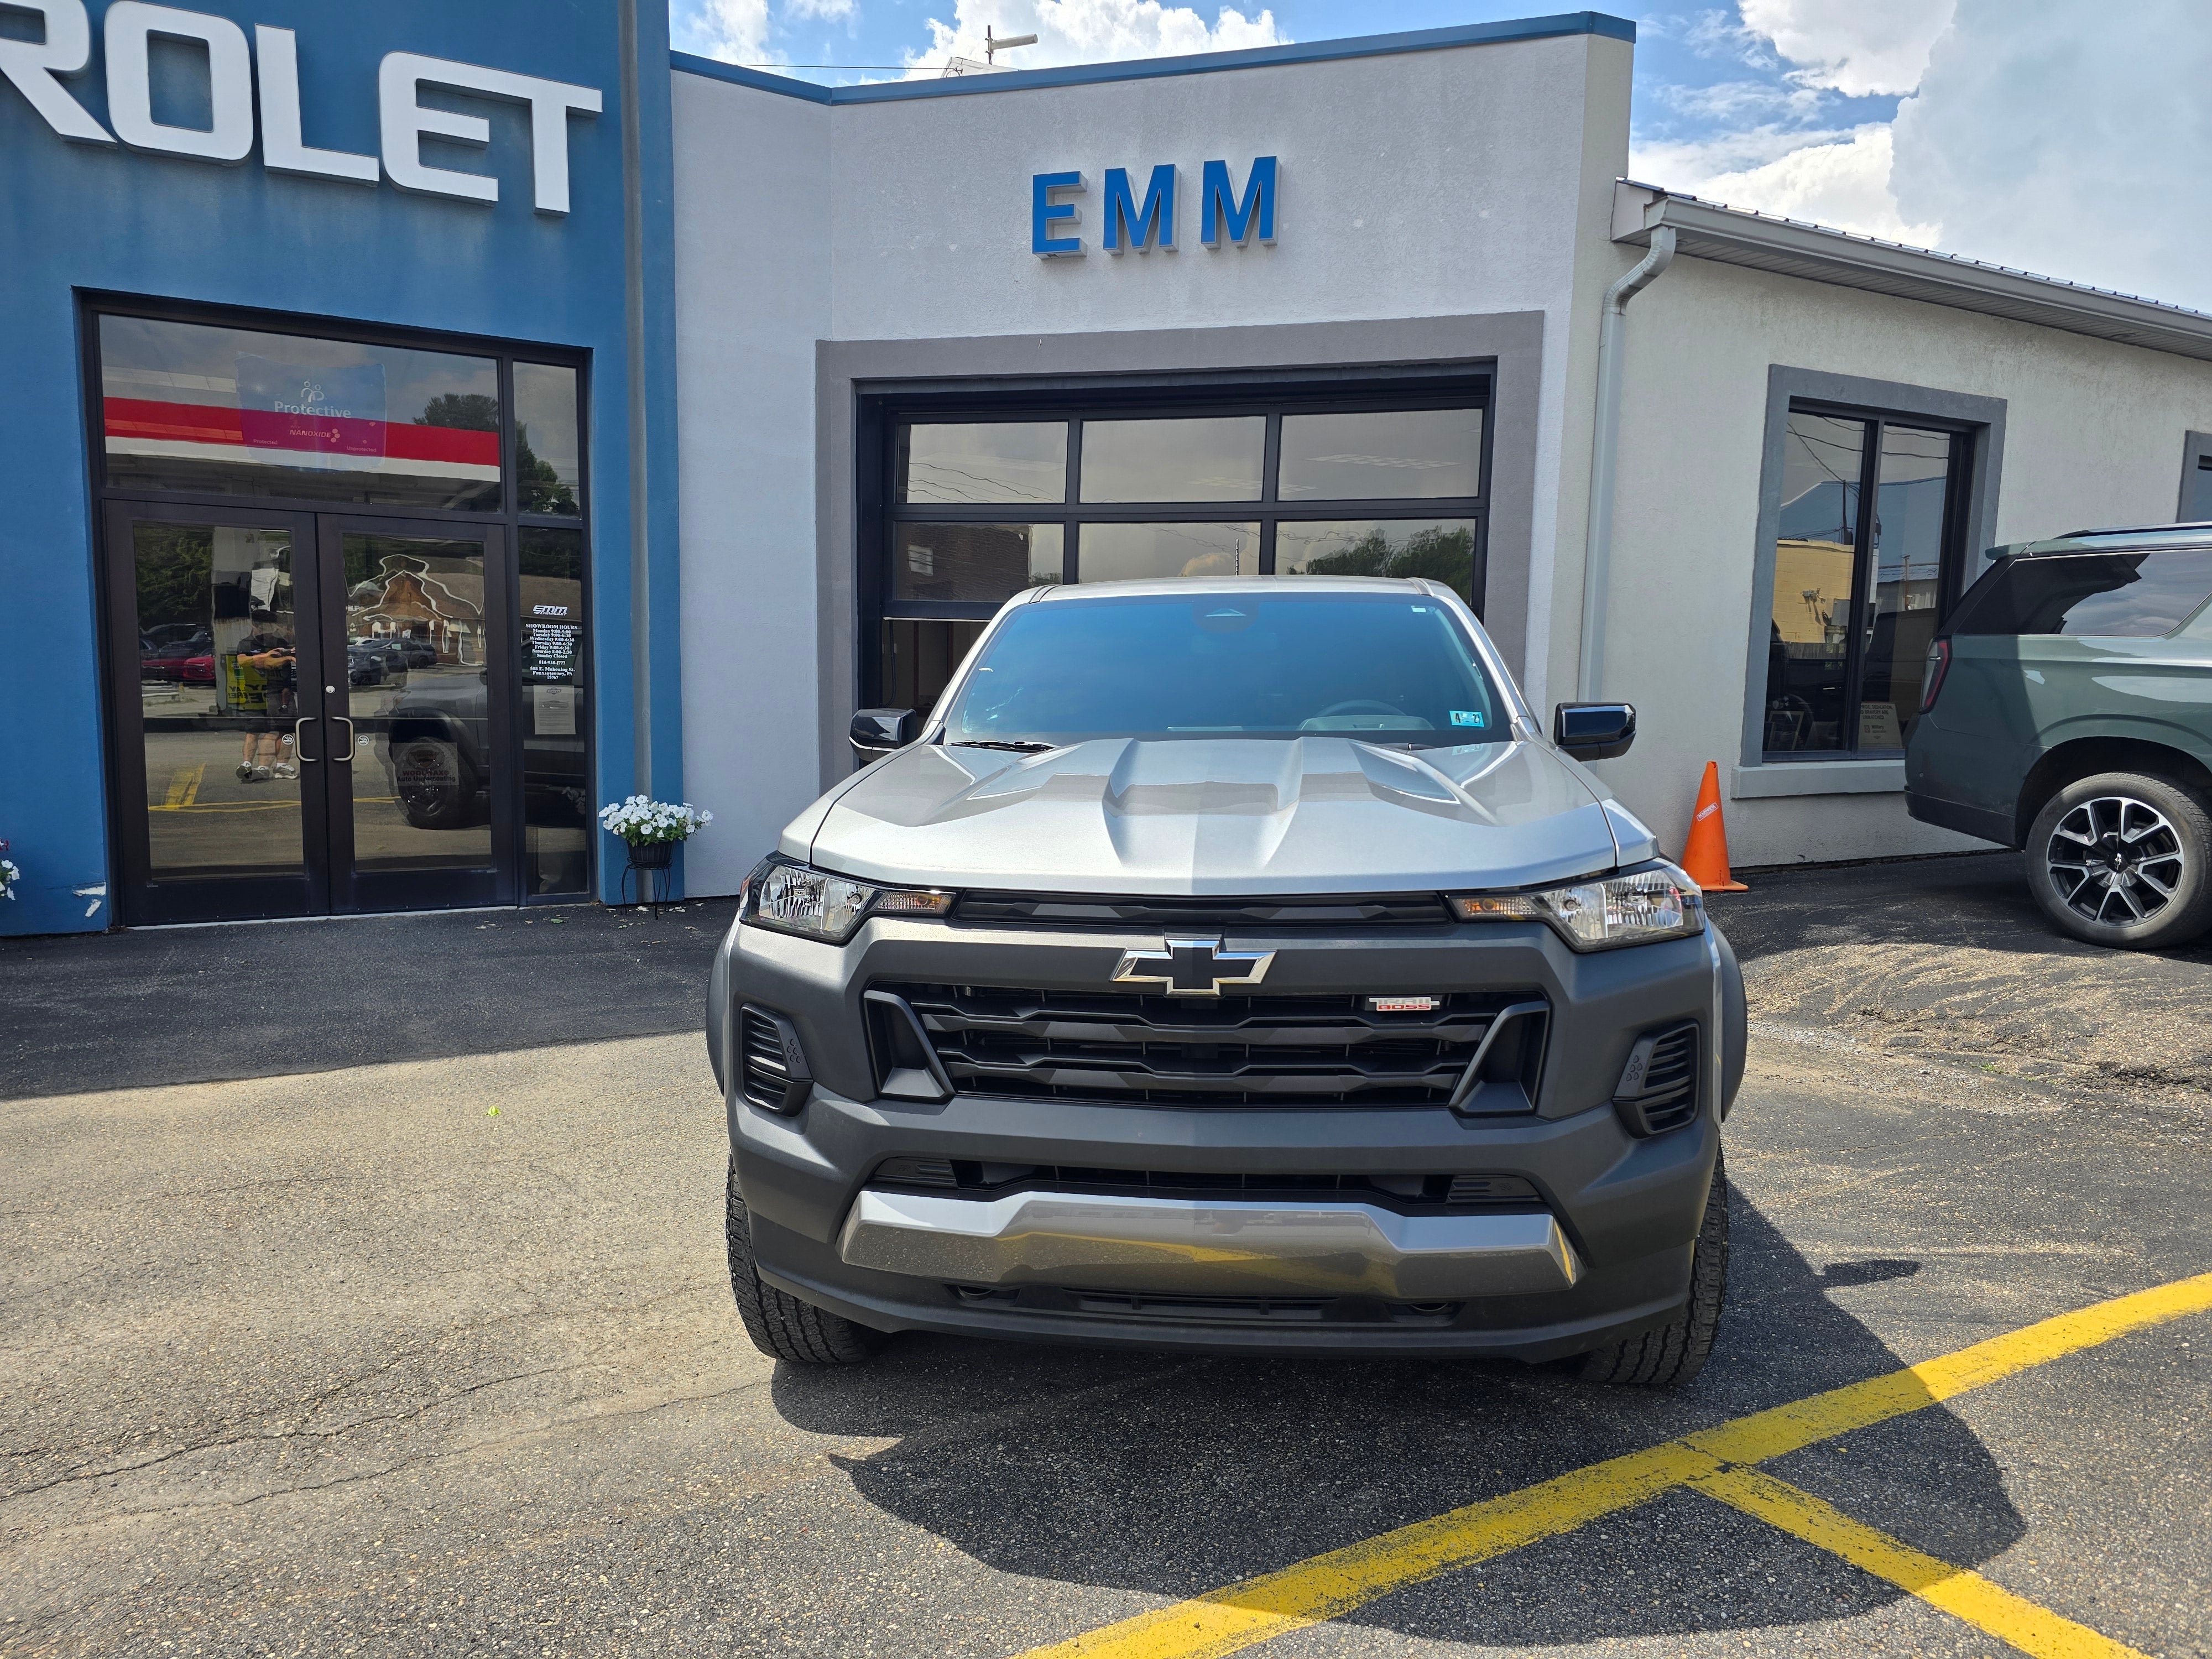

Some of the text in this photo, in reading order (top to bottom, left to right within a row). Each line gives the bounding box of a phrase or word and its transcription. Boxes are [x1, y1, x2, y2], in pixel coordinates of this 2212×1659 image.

[1032, 155, 1281, 260] EMM
[274, 401, 352, 418] Protective
[289, 429, 331, 438] NANOXIDE
[1369, 997, 1440, 1005] TRAIL
